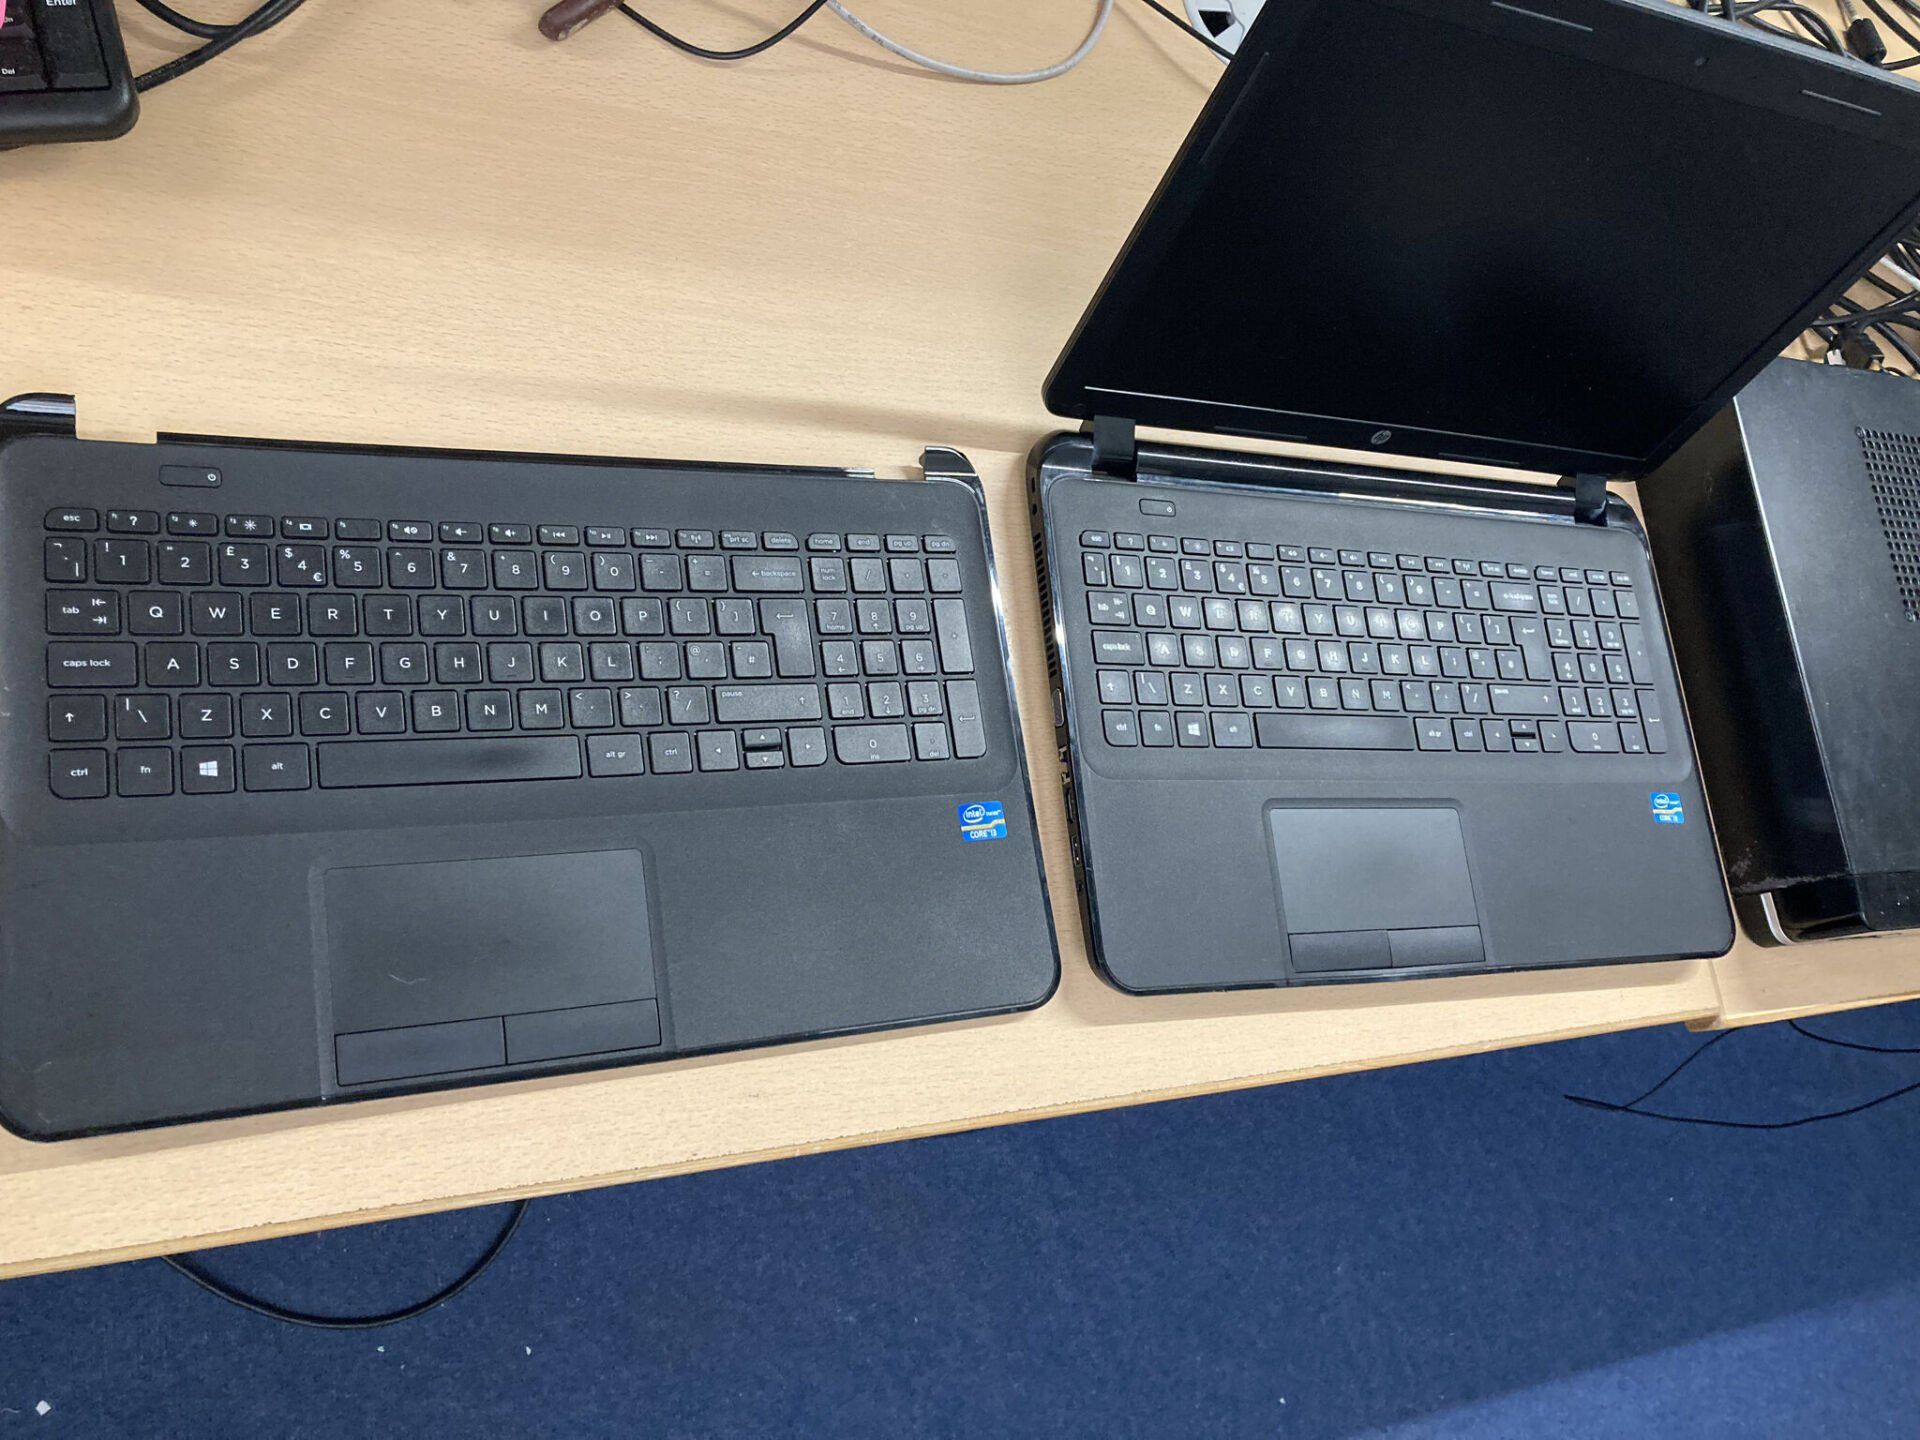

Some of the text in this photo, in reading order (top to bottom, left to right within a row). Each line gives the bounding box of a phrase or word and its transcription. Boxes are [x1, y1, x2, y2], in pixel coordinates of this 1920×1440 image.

[130, 516, 137, 525] ?
[227, 546, 234, 555] £
[285, 548, 293, 558] $
[340, 550, 350, 559] %
[120, 555, 125, 565] 1
[447, 552, 455, 561] &
[181, 557, 189, 567] 2
[241, 559, 249, 569] 3
[298, 560, 306, 570] 4
[354, 561, 362, 571] 5
[408, 563, 416, 572] 6
[461, 564, 467, 573] 7
[512, 565, 520, 574] 8
[562, 566, 569, 575] 9
[611, 567, 618, 576] 0
[313, 573, 321, 581] €
[149, 606, 163, 617] Q
[209, 608, 225, 618] W
[271, 608, 280, 619] E
[328, 609, 337, 619] R
[384, 609, 393, 619] T
[437, 610, 446, 620] Y
[489, 610, 499, 620] U
[544, 611, 547, 620] I
[590, 611, 600, 621] O
[639, 611, 647, 620] P
[831, 611, 837, 620] 7
[871, 612, 878, 620] 8
[910, 612, 916, 620] 9
[690, 646, 700, 655] @
[454, 657, 464, 667] H
[508, 657, 515, 667] J
[558, 657, 567, 666] K
[608, 657, 616, 666] L
[837, 654, 844, 662] 4
[877, 654, 884, 662] 5
[916, 653, 923, 662] 6
[167, 658, 179, 669] A
[230, 658, 239, 669] S
[288, 658, 298, 669] D
[346, 658, 354, 668] F
[400, 658, 410, 668] G
[721, 690, 743, 698] pause
[923, 694, 929, 703] 3
[845, 697, 848, 705] 1
[884, 696, 890, 704] 2
[320, 708, 330, 719] C
[376, 707, 386, 717] V
[432, 706, 441, 716] B
[485, 705, 495, 715] N
[536, 704, 547, 714] M
[202, 710, 212, 721] Z
[262, 709, 272, 720] X
[869, 739, 877, 748] 0
[617, 751, 626, 759] gr
[71, 768, 88, 776] ctrl
